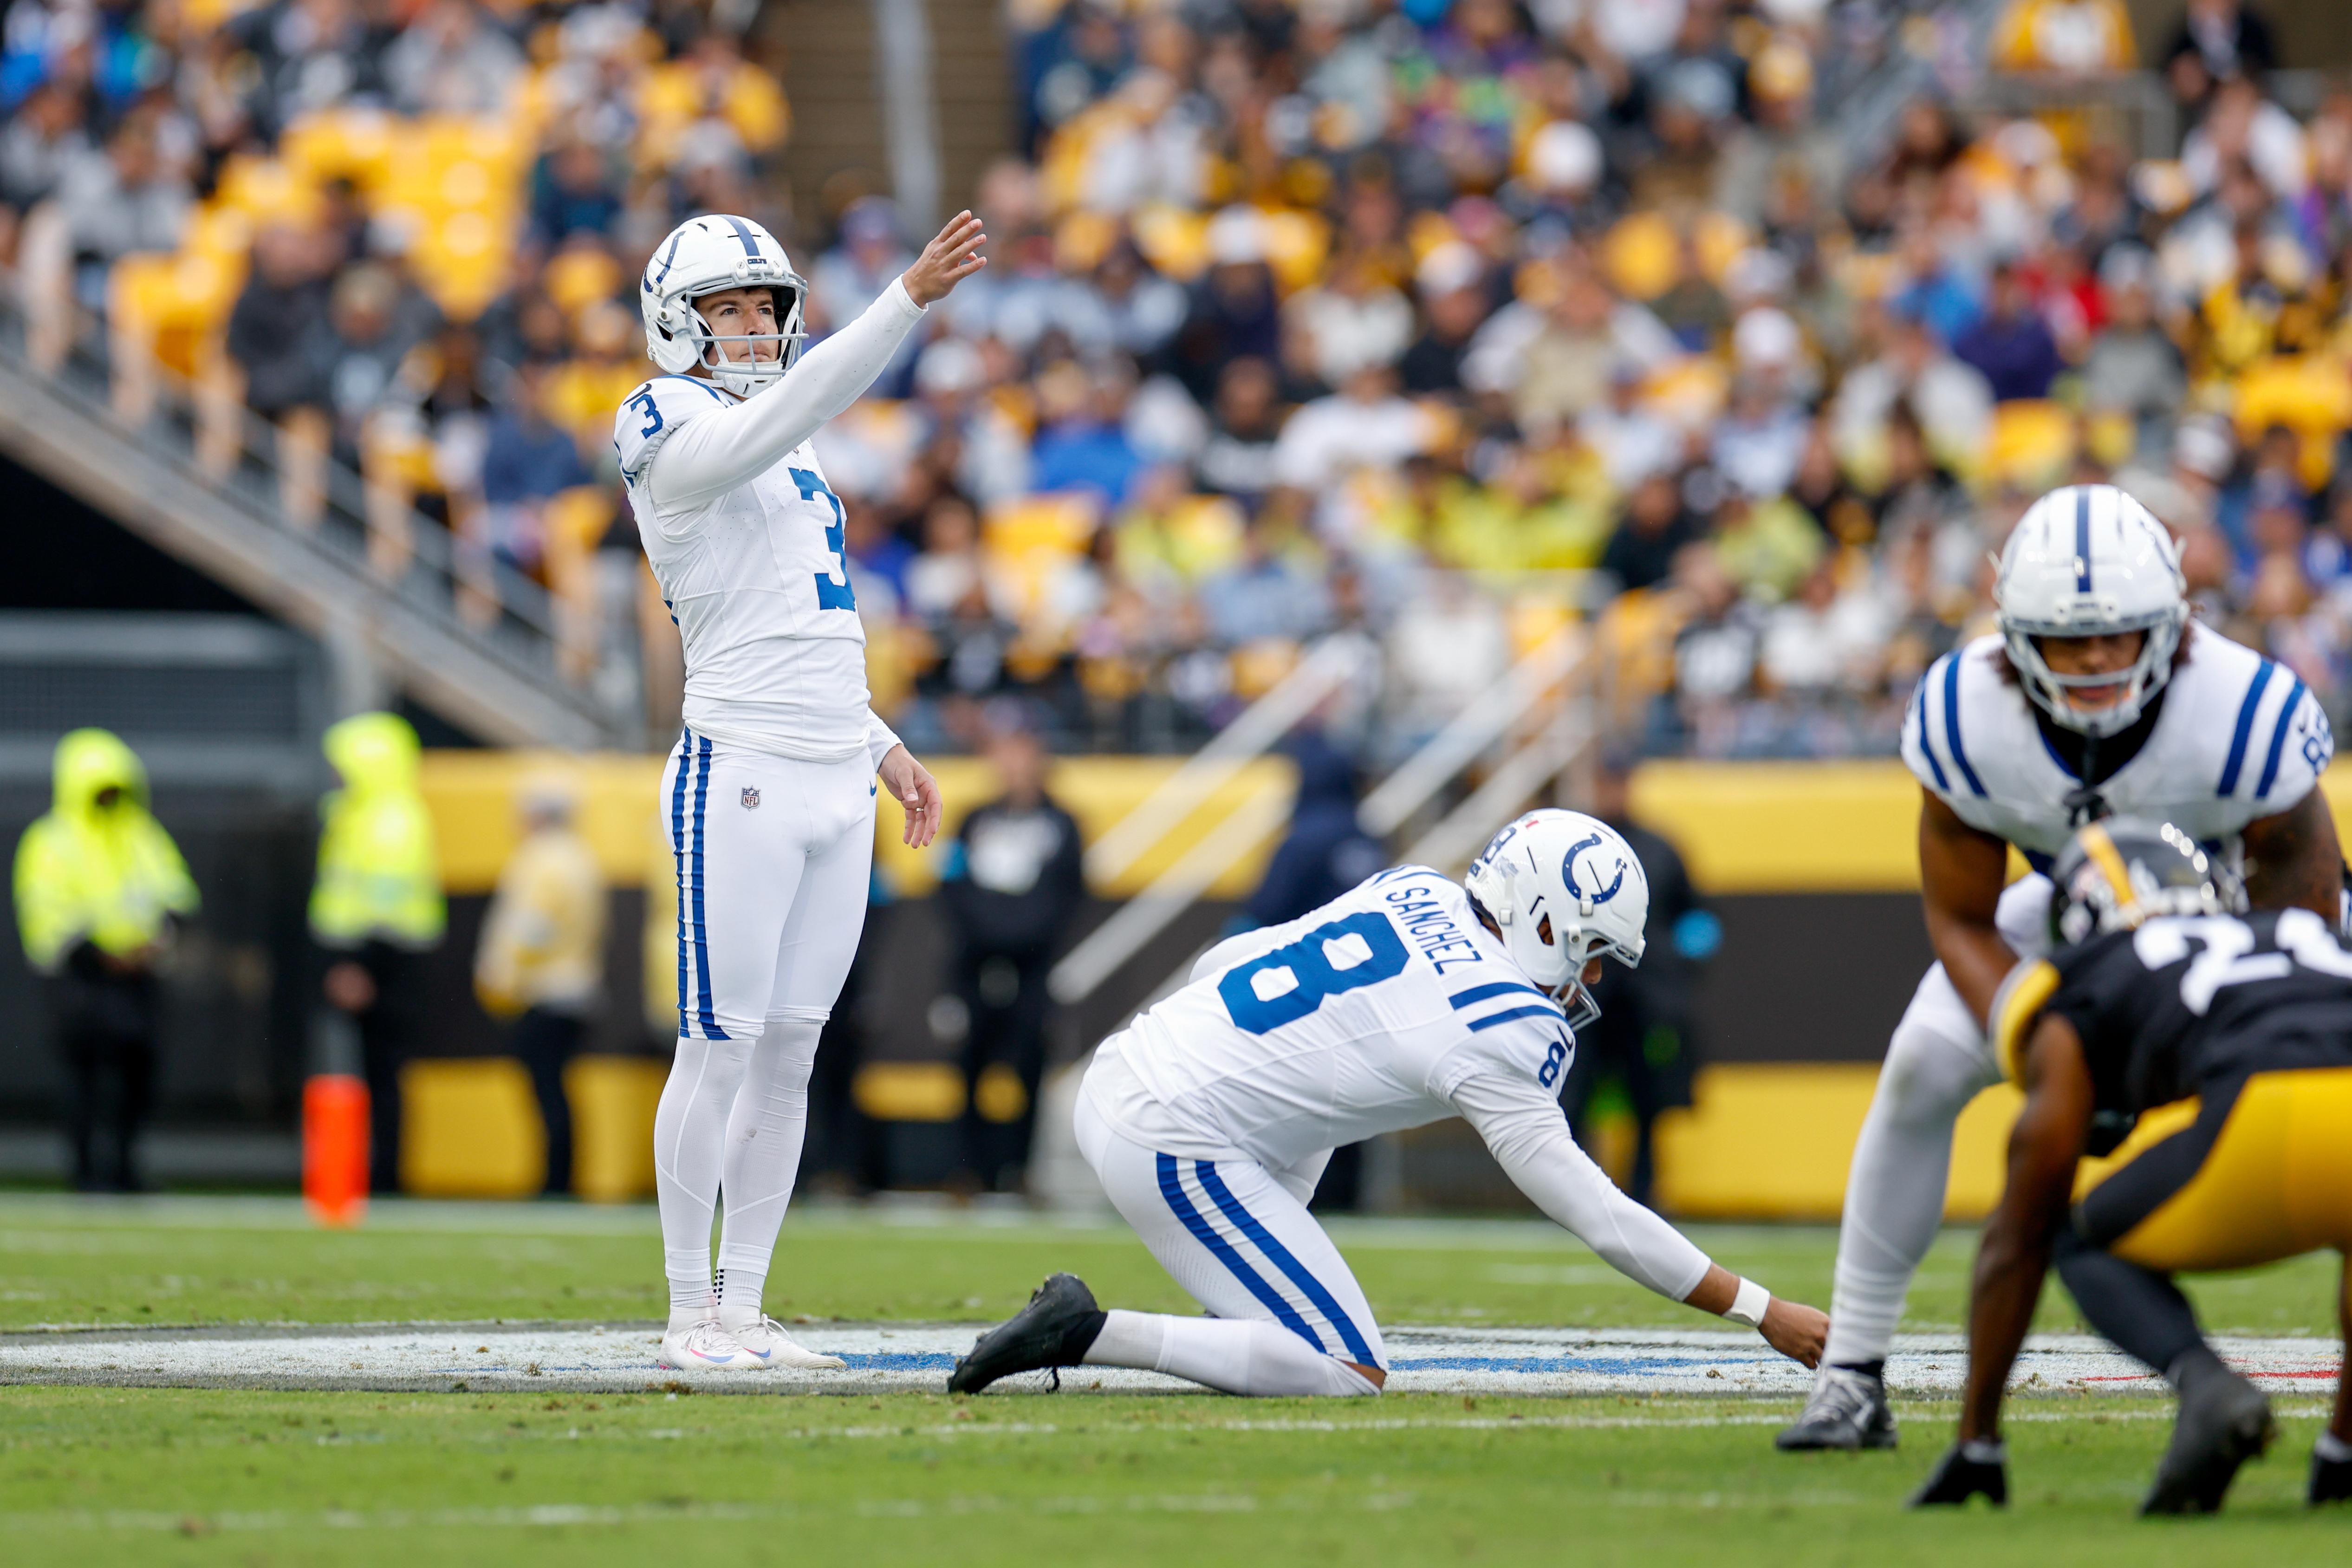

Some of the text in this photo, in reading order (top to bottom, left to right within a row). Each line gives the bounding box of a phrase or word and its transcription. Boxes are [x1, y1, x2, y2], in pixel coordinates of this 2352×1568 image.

[630, 393, 663, 439] 3
[788, 467, 856, 612] 3
[744, 796, 757, 806] NFL
[1481, 826, 1517, 865] 8
[1386, 887, 1483, 976] SANCHEZ
[1217, 912, 1410, 1035] 8
[1539, 1041, 1566, 1088] 8
